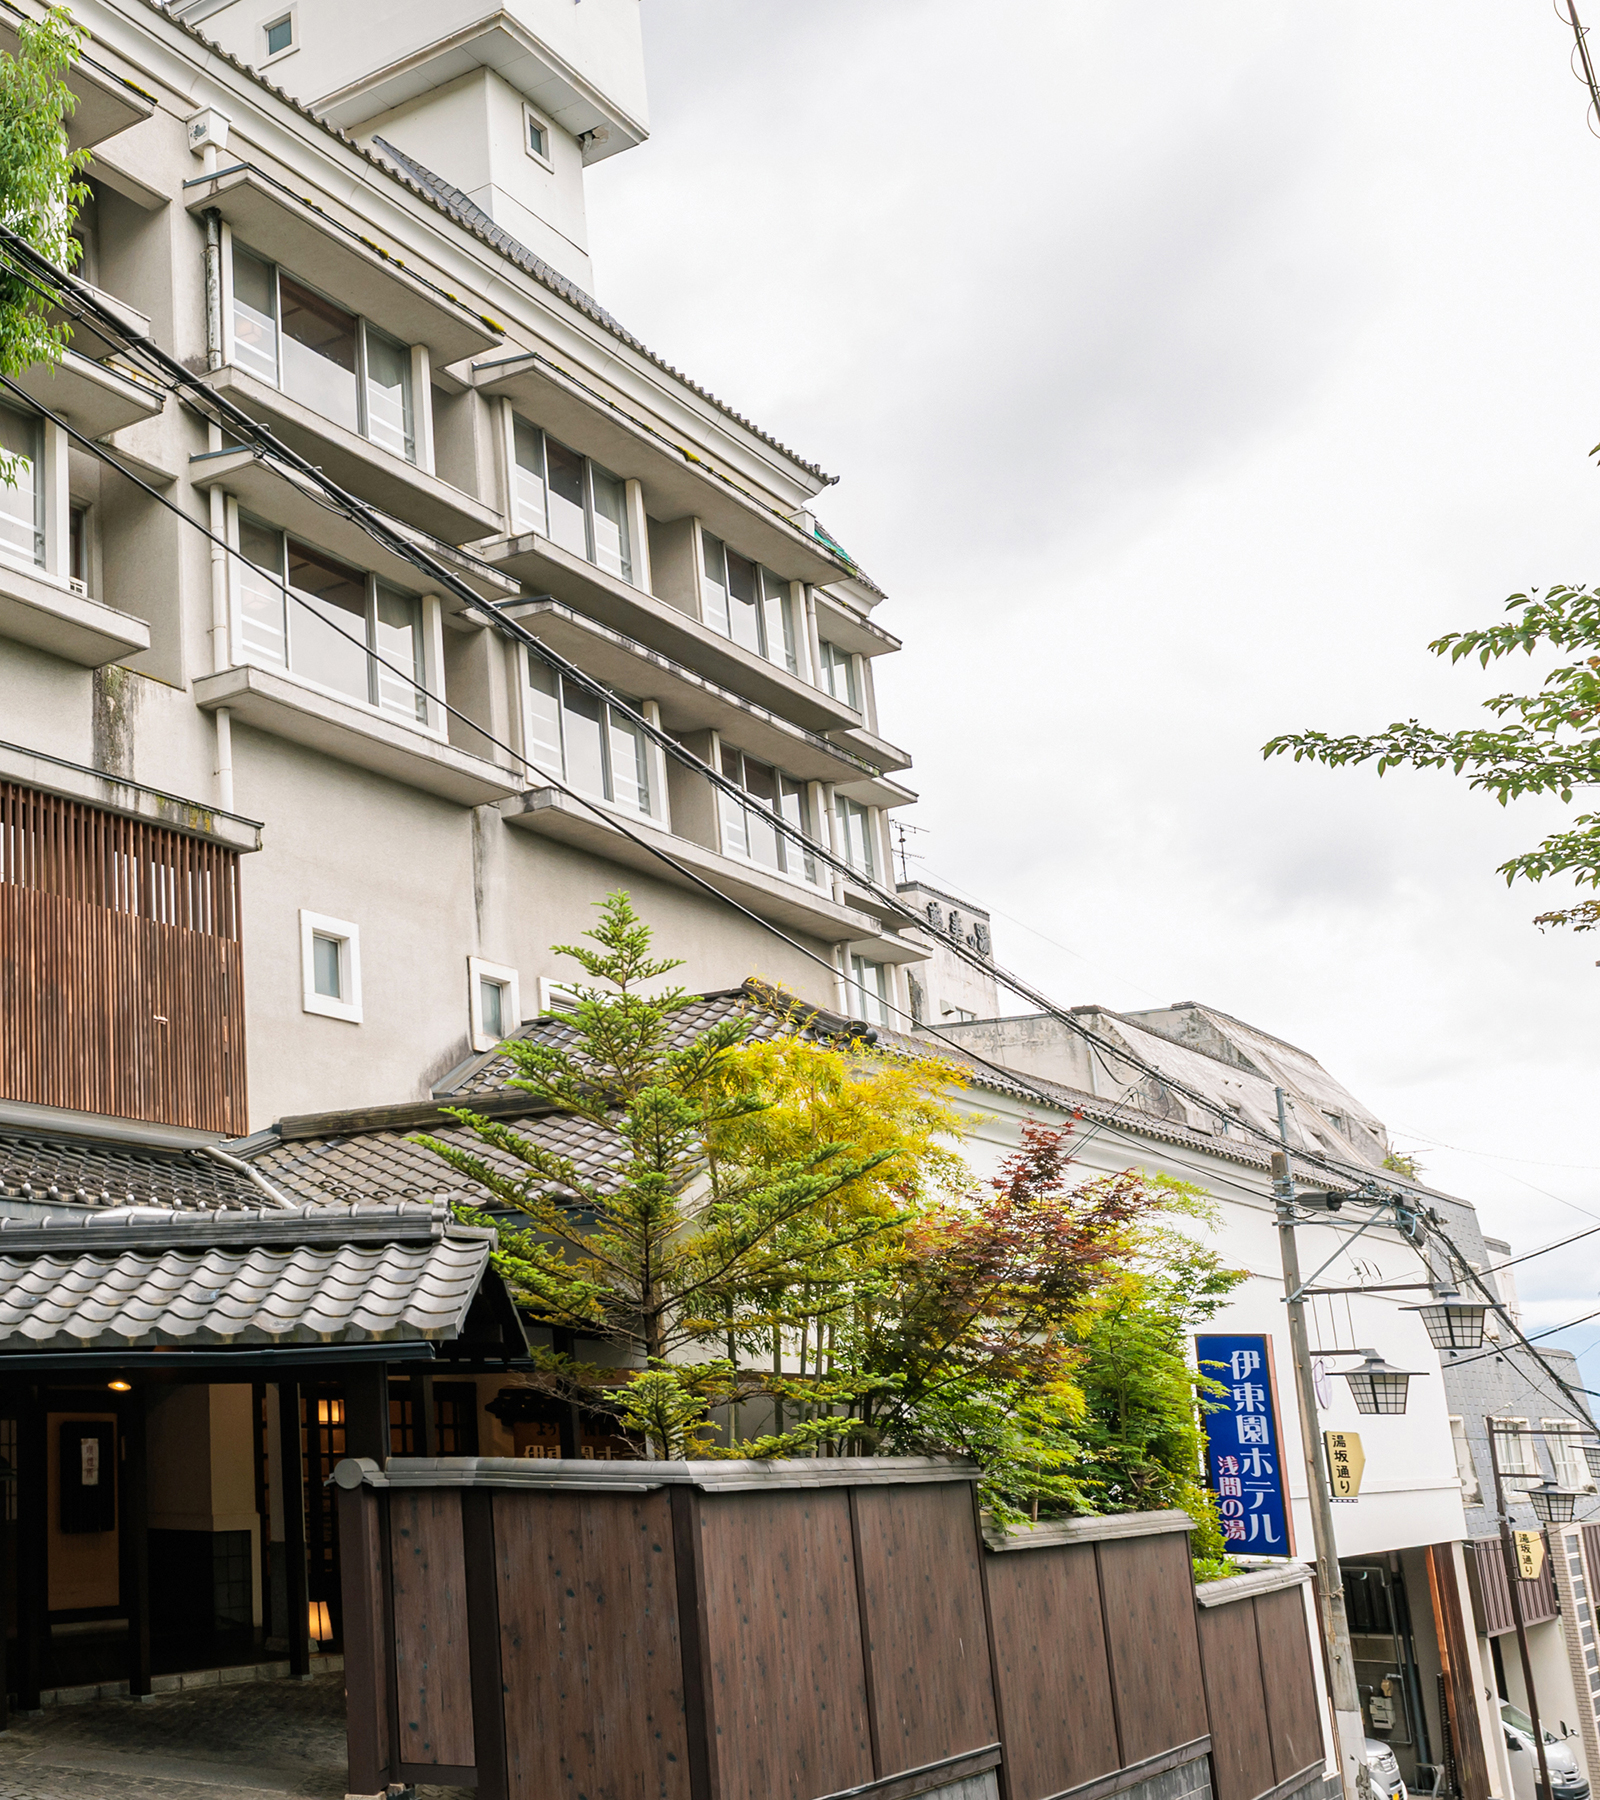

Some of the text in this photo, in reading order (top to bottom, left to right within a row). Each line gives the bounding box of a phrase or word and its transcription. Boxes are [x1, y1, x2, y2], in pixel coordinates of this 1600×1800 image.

[1230, 1350, 1281, 1543] 伊東園ホテル
[1331, 1434, 1351, 1494] 湯坂通り
[1217, 1455, 1247, 1541] 浅間の湯
